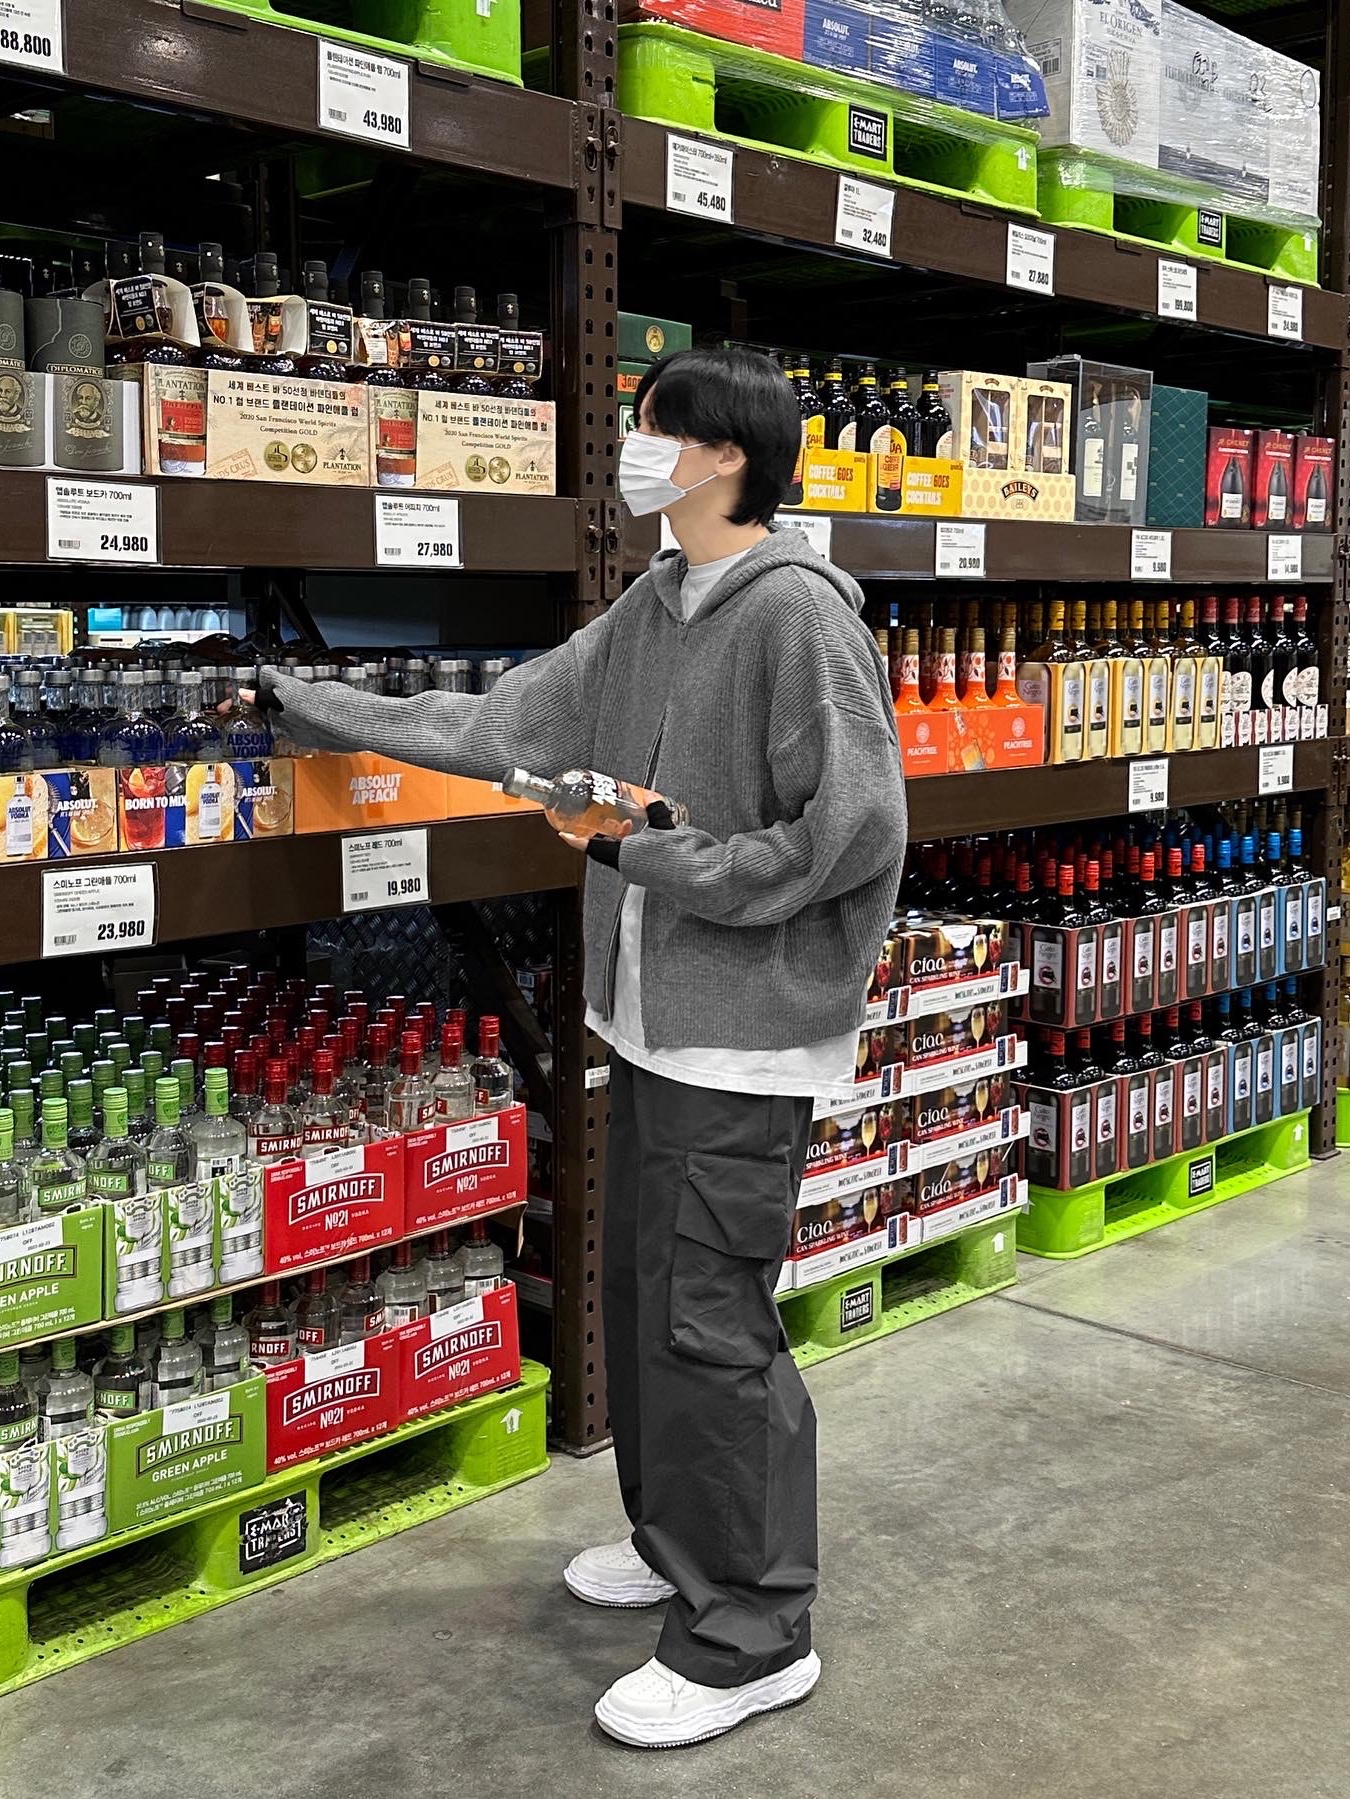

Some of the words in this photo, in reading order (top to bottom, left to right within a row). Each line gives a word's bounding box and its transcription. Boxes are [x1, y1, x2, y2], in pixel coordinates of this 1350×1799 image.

[383, 67, 401, 79] 700ml
[363, 109, 402, 135] 43,980
[853, 128, 882, 149] TRADERS
[697, 191, 726, 212] 45,480
[862, 228, 887, 247] 32,480
[228, 380, 244, 390] 세계
[247, 383, 269, 393] 베스트
[273, 385, 280, 394] 바
[283, 386, 307, 397] 50선정
[246, 398, 269, 409] 브랜드
[272, 400, 314, 412] 플랜테이션
[317, 404, 348, 416] 파인애플
[435, 400, 448, 409] 세계
[450, 402, 470, 411] 베스트
[481, 405, 502, 414] 50선정
[299, 418, 316, 426] World
[450, 416, 470, 425] 브랜드
[260, 426, 297, 434] Competition
[299, 428, 317, 436] GOLD
[323, 462, 361, 470] PLANTATION
[809, 464, 836, 481] COFFEE
[837, 467, 853, 481] GOES
[906, 472, 932, 487] COFFEE
[933, 475, 950, 488] GOES
[56, 486, 85, 497] 앱솔루트
[86, 488, 107, 499] 보드카
[109, 491, 132, 501] 700ml
[808, 483, 845, 499] COCKTAILS
[906, 490, 942, 505] COCKTAILS
[1003, 482, 1037, 498] BAILEYS
[382, 502, 404, 510] 앱솔루트
[422, 504, 440, 513] 700ml
[100, 534, 148, 552] 24,980
[417, 543, 453, 557] 27,980
[907, 746, 938, 756] PEACHTREE
[1004, 740, 1033, 750] PEACHTREE
[350, 773, 402, 791] ABSOLUT
[125, 797, 154, 810] BORN
[156, 796, 168, 808] TO
[169, 795, 187, 807] MIX
[353, 788, 398, 805] APEACH
[349, 841, 371, 852] 스미노프
[384, 838, 402, 848] 700ml
[53, 878, 82, 889] 스미노프
[84, 876, 112, 887] 그린애플
[114, 874, 136, 884] 700ml
[387, 877, 421, 896] 19,980
[97, 920, 145, 941] 23,980
[909, 957, 945, 975] Ciao
[912, 1032, 944, 1052] Ciao
[917, 1107, 949, 1127] Ciao
[432, 1145, 502, 1178] SMIRNOFF
[297, 1179, 376, 1214] SMIRNOFF
[921, 1180, 952, 1201] Ciao
[797, 1220, 833, 1244] Ciao
[809, 1238, 835, 1250] SPARKLING
[836, 1231, 850, 1242] WINE
[19, 1283, 59, 1302] APPLE
[846, 1303, 869, 1321] TRADERS
[422, 1327, 493, 1368] SMIRNOFF
[292, 1375, 371, 1414] SMIRNOFF
[152, 1462, 190, 1482] GREEN
[192, 1449, 227, 1469] APPLE
